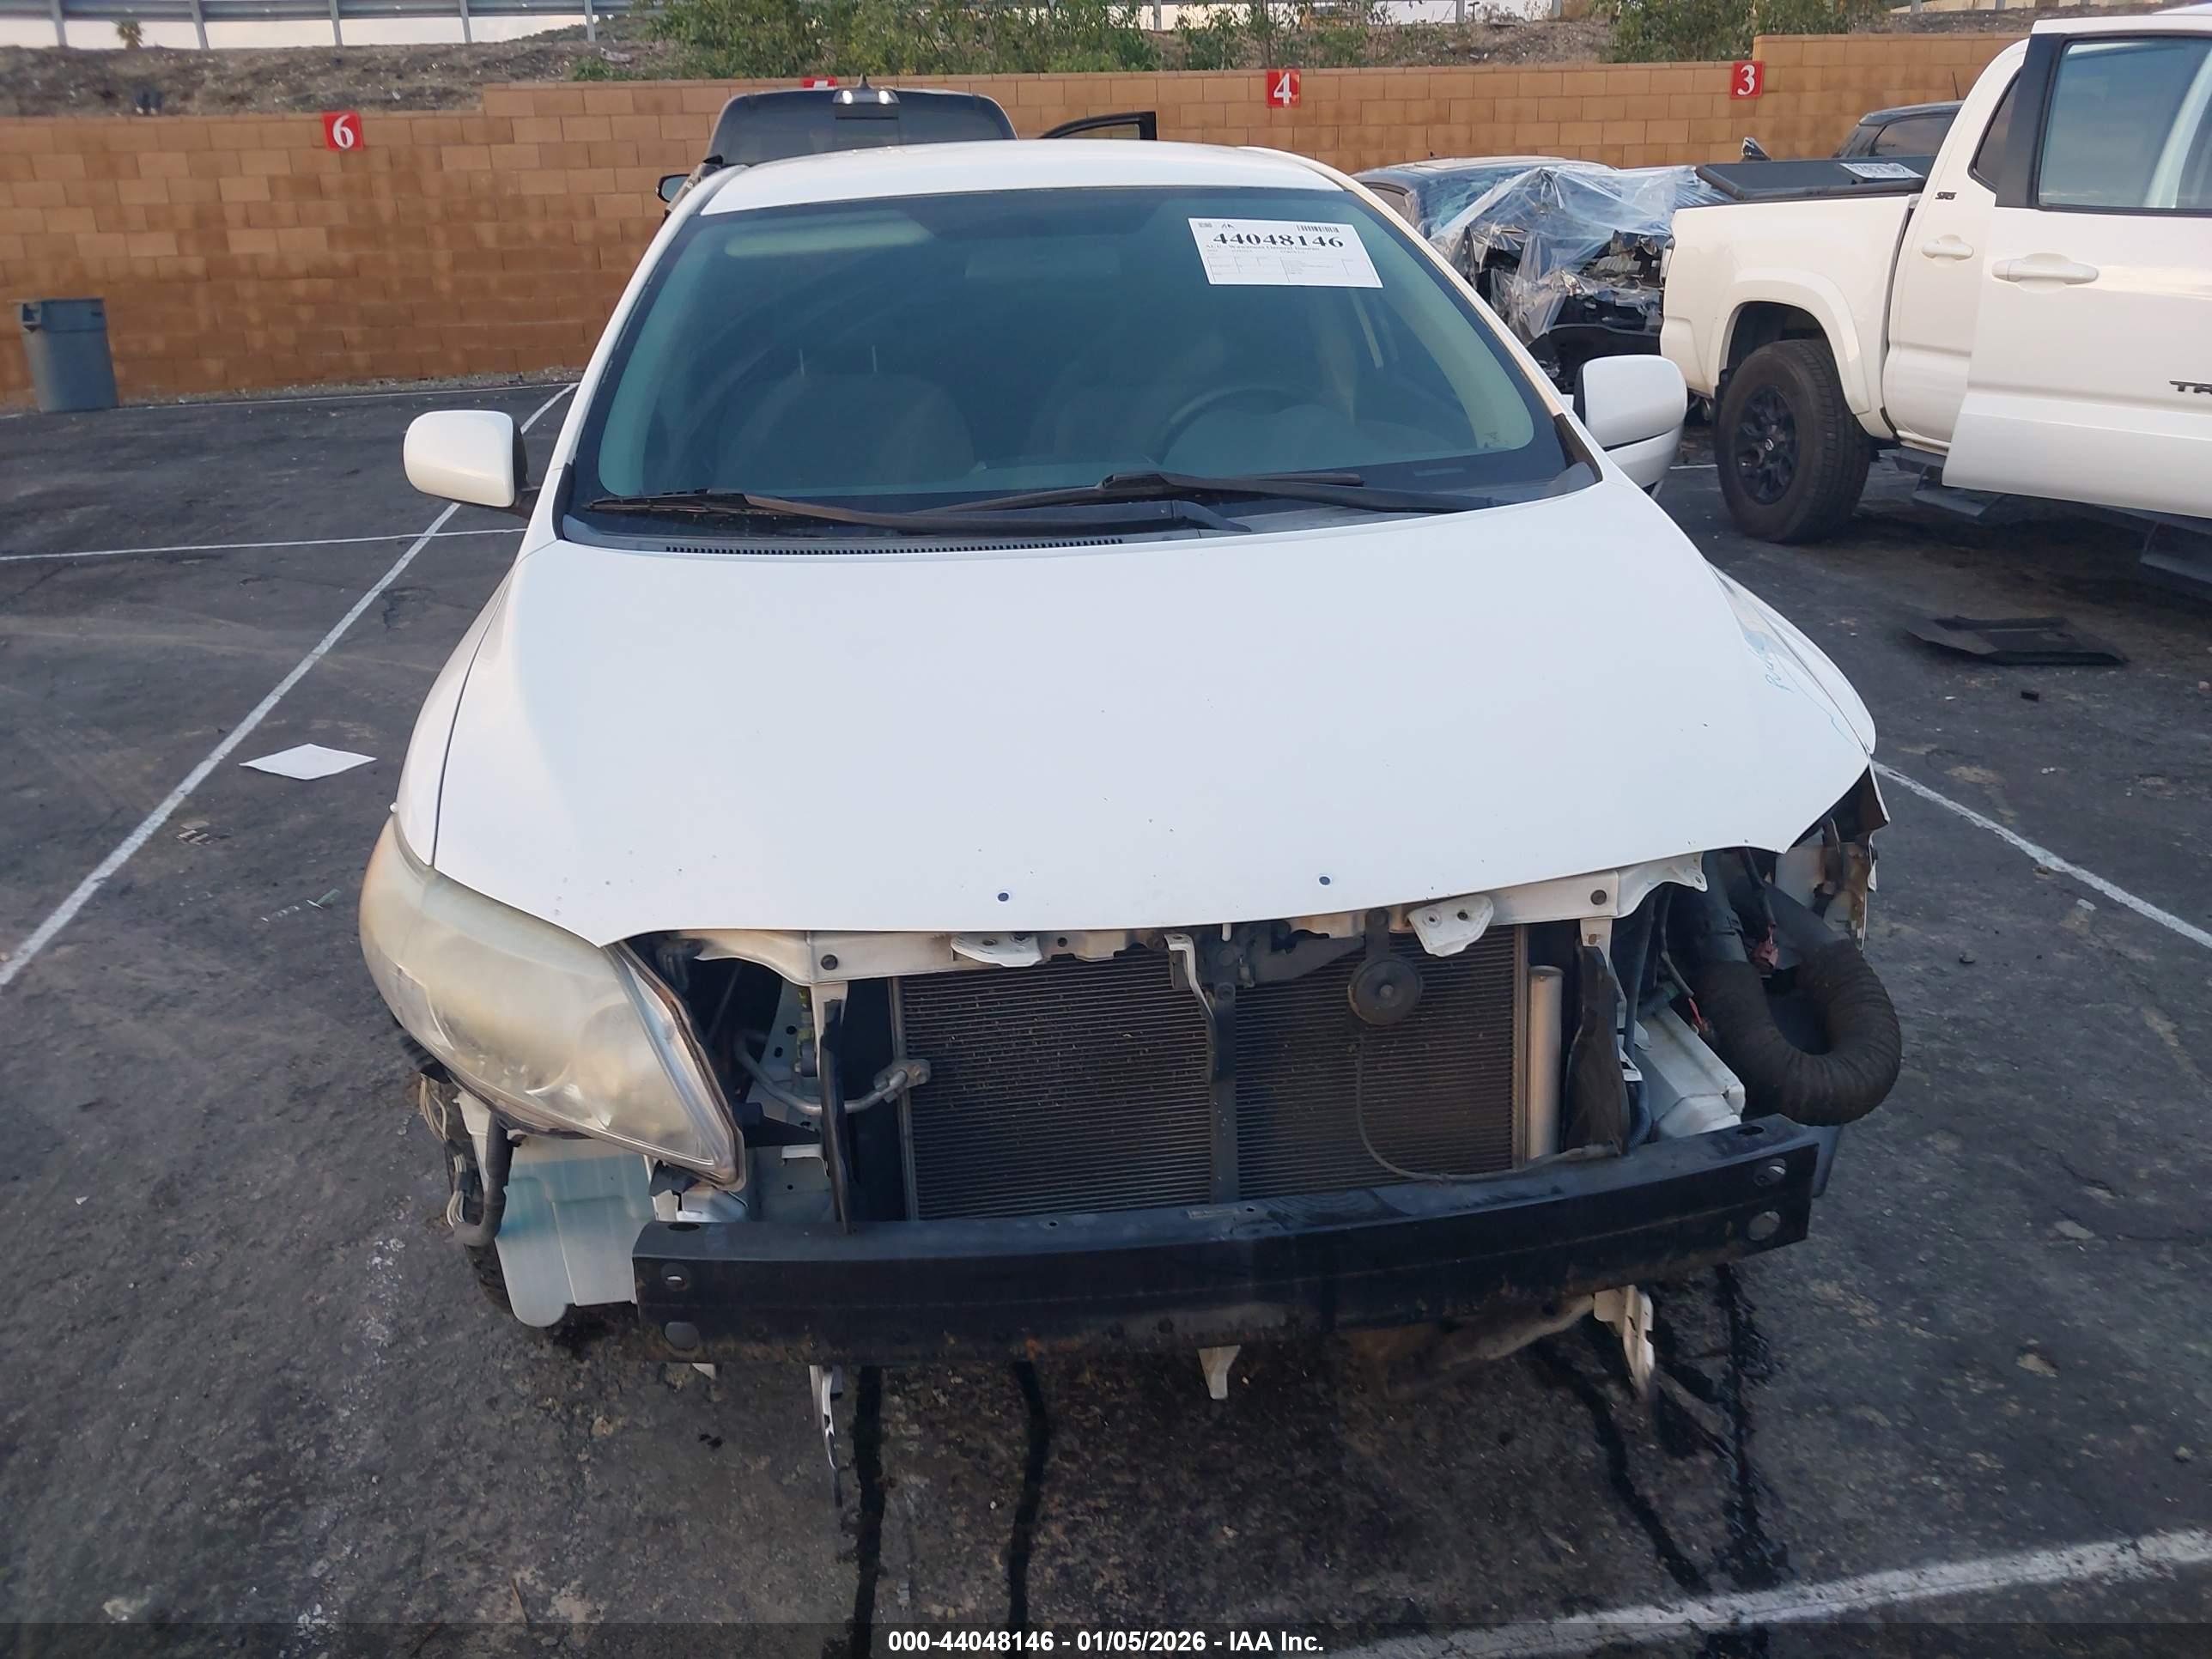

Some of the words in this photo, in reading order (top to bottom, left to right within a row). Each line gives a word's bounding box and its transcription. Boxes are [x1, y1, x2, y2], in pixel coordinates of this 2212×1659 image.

[1273, 74, 1292, 104] 4
[1737, 64, 1756, 95] 3
[332, 116, 355, 149] 6
[1212, 233, 1344, 248] 44048146
